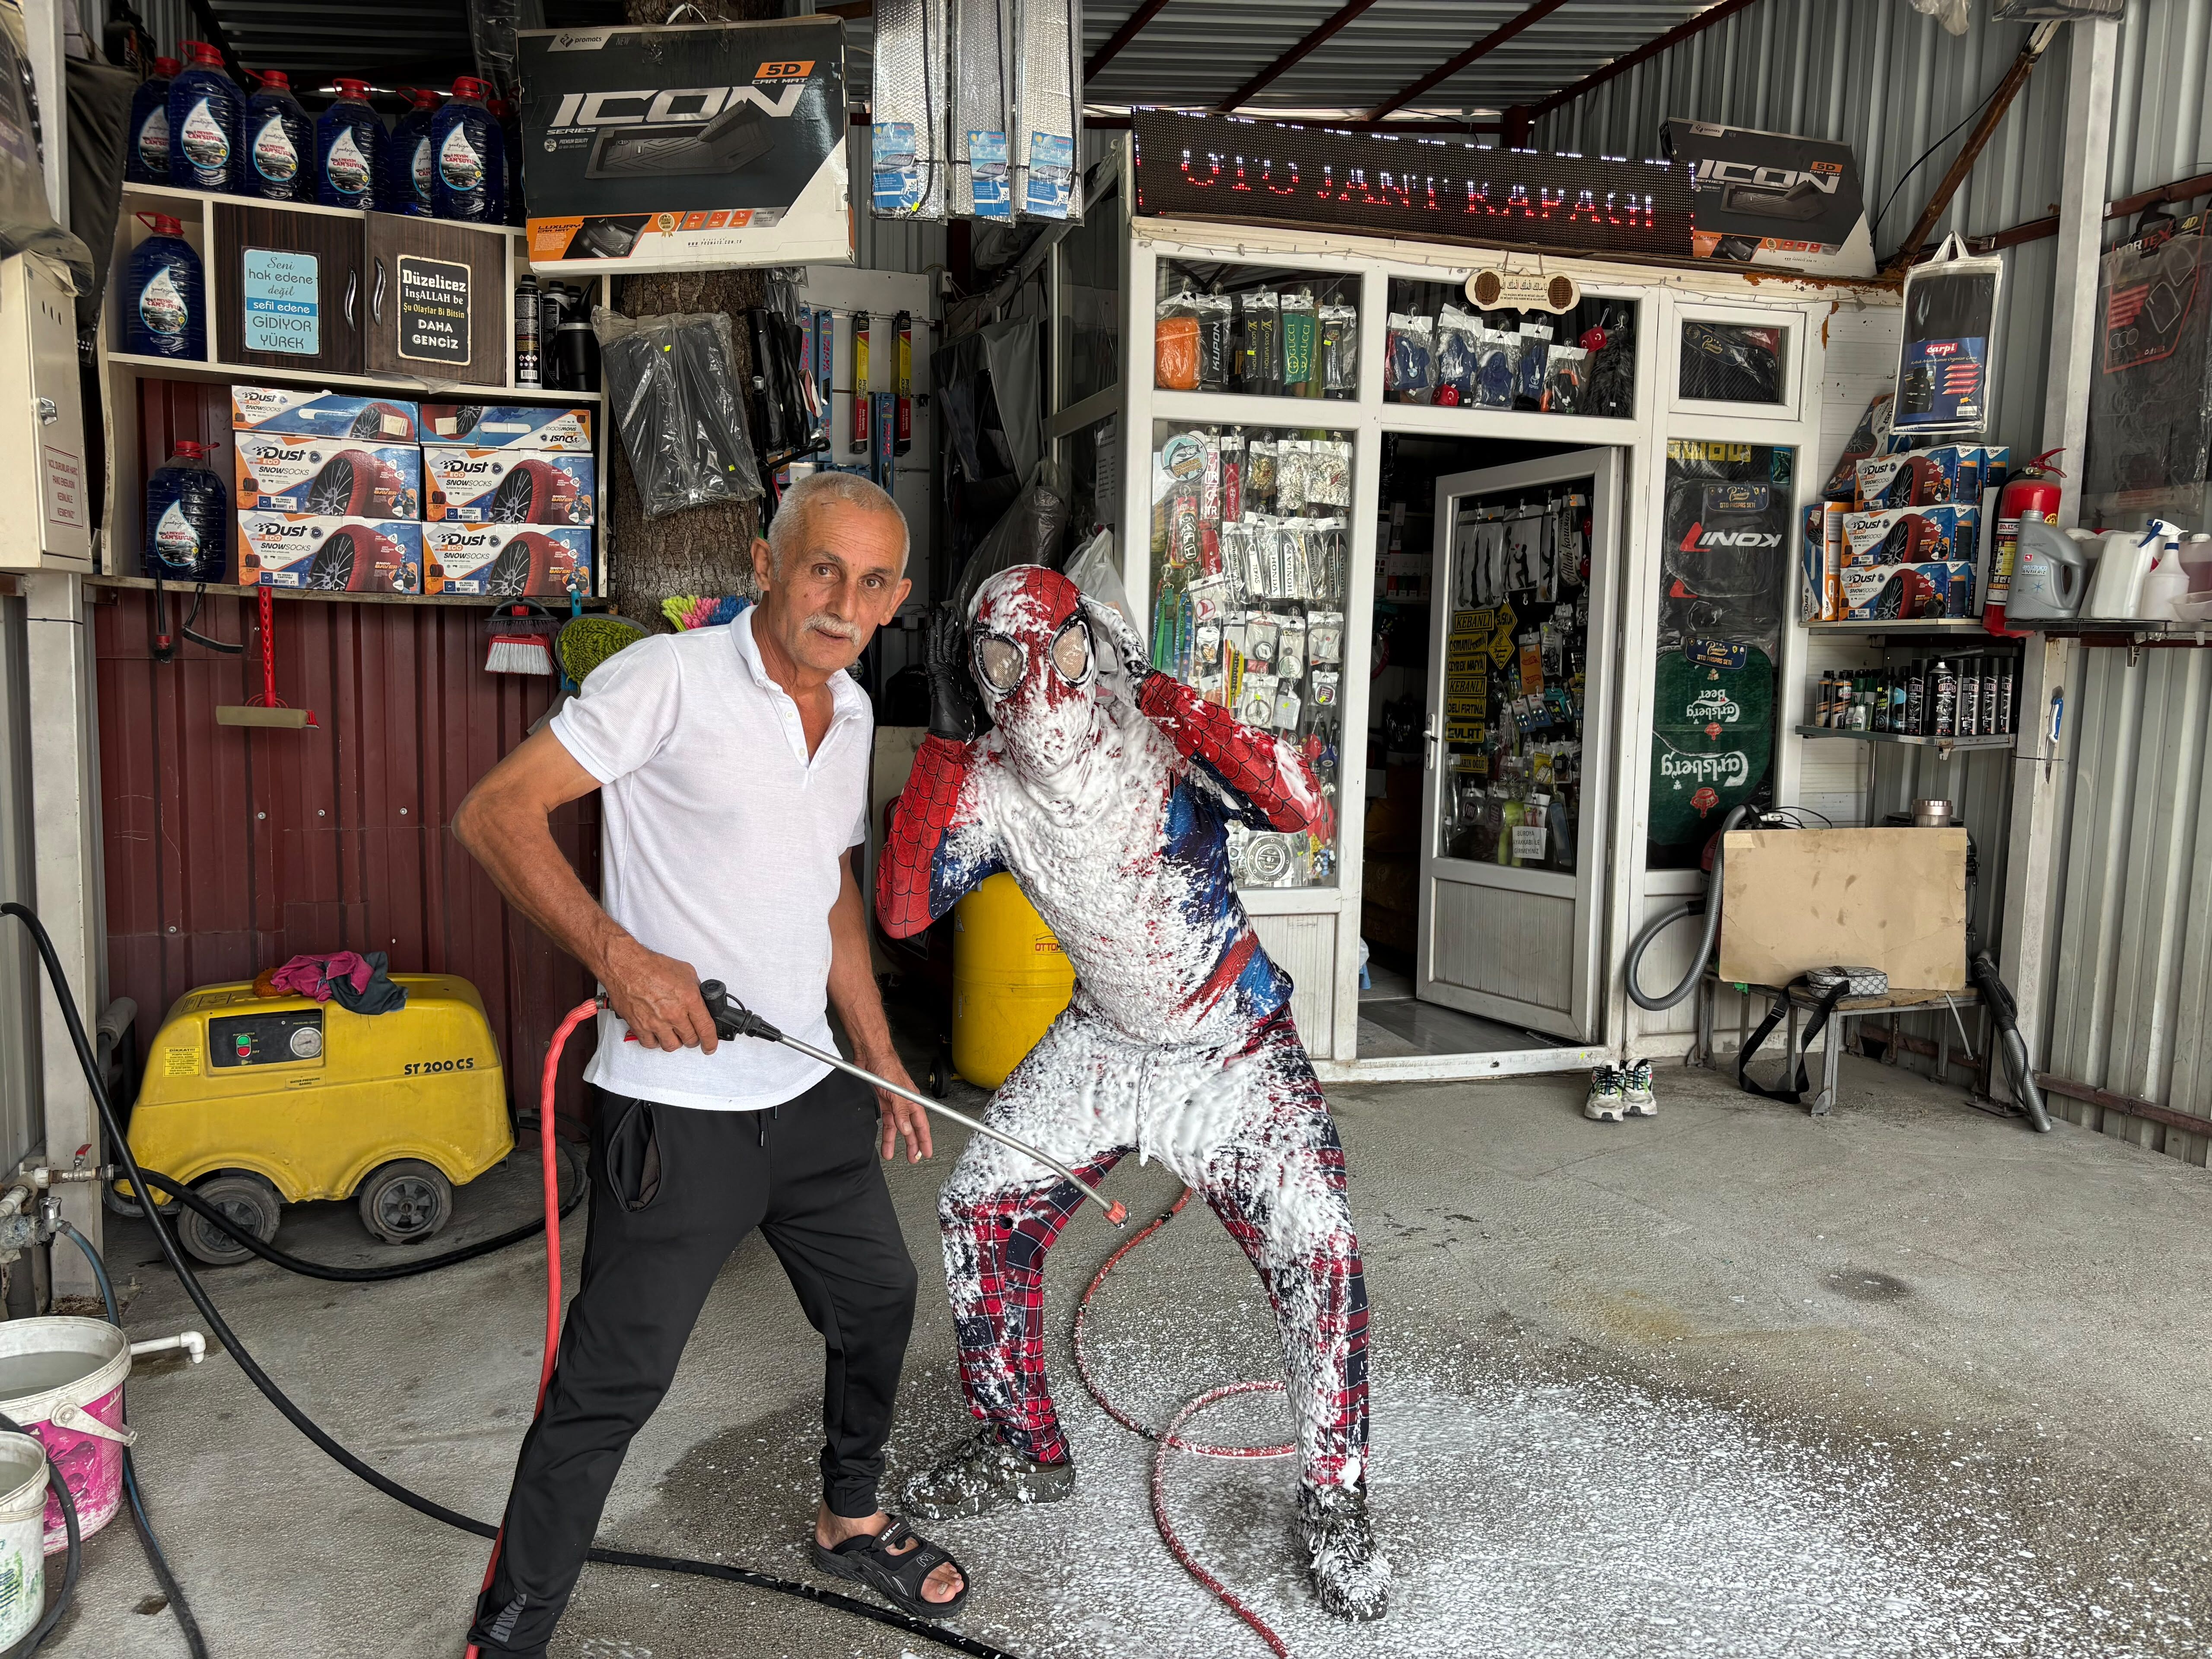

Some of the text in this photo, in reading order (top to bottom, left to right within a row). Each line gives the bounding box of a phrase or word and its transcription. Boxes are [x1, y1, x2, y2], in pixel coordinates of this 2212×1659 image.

[616, 37, 630, 46] NEW
[765, 63, 801, 76] 5D
[550, 84, 805, 127] ICON
[1697, 159, 1840, 194] ICON
[2181, 216, 2198, 229] 4D
[267, 257, 296, 270] Seni
[249, 268, 313, 284] hak edene
[402, 269, 466, 292] Düzelicez
[268, 285, 295, 299] değil
[405, 286, 464, 305] İnşALLAH be
[253, 301, 310, 314] sefil edene
[403, 302, 412, 313] Şu
[413, 304, 437, 315] Olaylar
[447, 308, 465, 319] Bitsin
[253, 314, 311, 332] GİDİYOR
[418, 319, 453, 333] DAHA
[260, 332, 304, 349] YÜREK
[412, 334, 459, 350] GENCİZ
[1212, 321, 1220, 371] KUPON
[1702, 334, 1723, 354] Premium
[1927, 343, 1955, 356] carpi
[249, 392, 276, 402] Dust
[263, 447, 306, 461] Dust
[258, 466, 309, 475] SNOWSOCKS
[451, 460, 489, 473] Dust
[1867, 464, 1888, 474] Dust
[1727, 486, 1750, 501] Premium
[264, 523, 308, 537] Dust
[1857, 519, 1881, 529] Dust
[449, 534, 486, 546] Dust
[1698, 531, 1783, 547] KONI
[261, 543, 311, 552] SNOWSOCKS
[1561, 511, 1579, 582] Allah korusun
[1852, 574, 1876, 583] Dust
[1456, 614, 1491, 628] KEBANLI
[1706, 641, 1728, 656] Premium
[1467, 659, 1483, 671] MAFYA
[1449, 681, 1483, 693] KEBANLI
[1699, 689, 1726, 701] Beer
[1448, 702, 1484, 713] DELİ FIRTINA
[1686, 699, 1739, 723] Carlsberg
[1448, 728, 1481, 738] EVLAT
[1660, 751, 1748, 787] Carlsberg
[1464, 804, 1476, 815] FIAT
[404, 1058, 474, 1075] ST 200 CS
[881, 1529, 893, 1541] MAX
